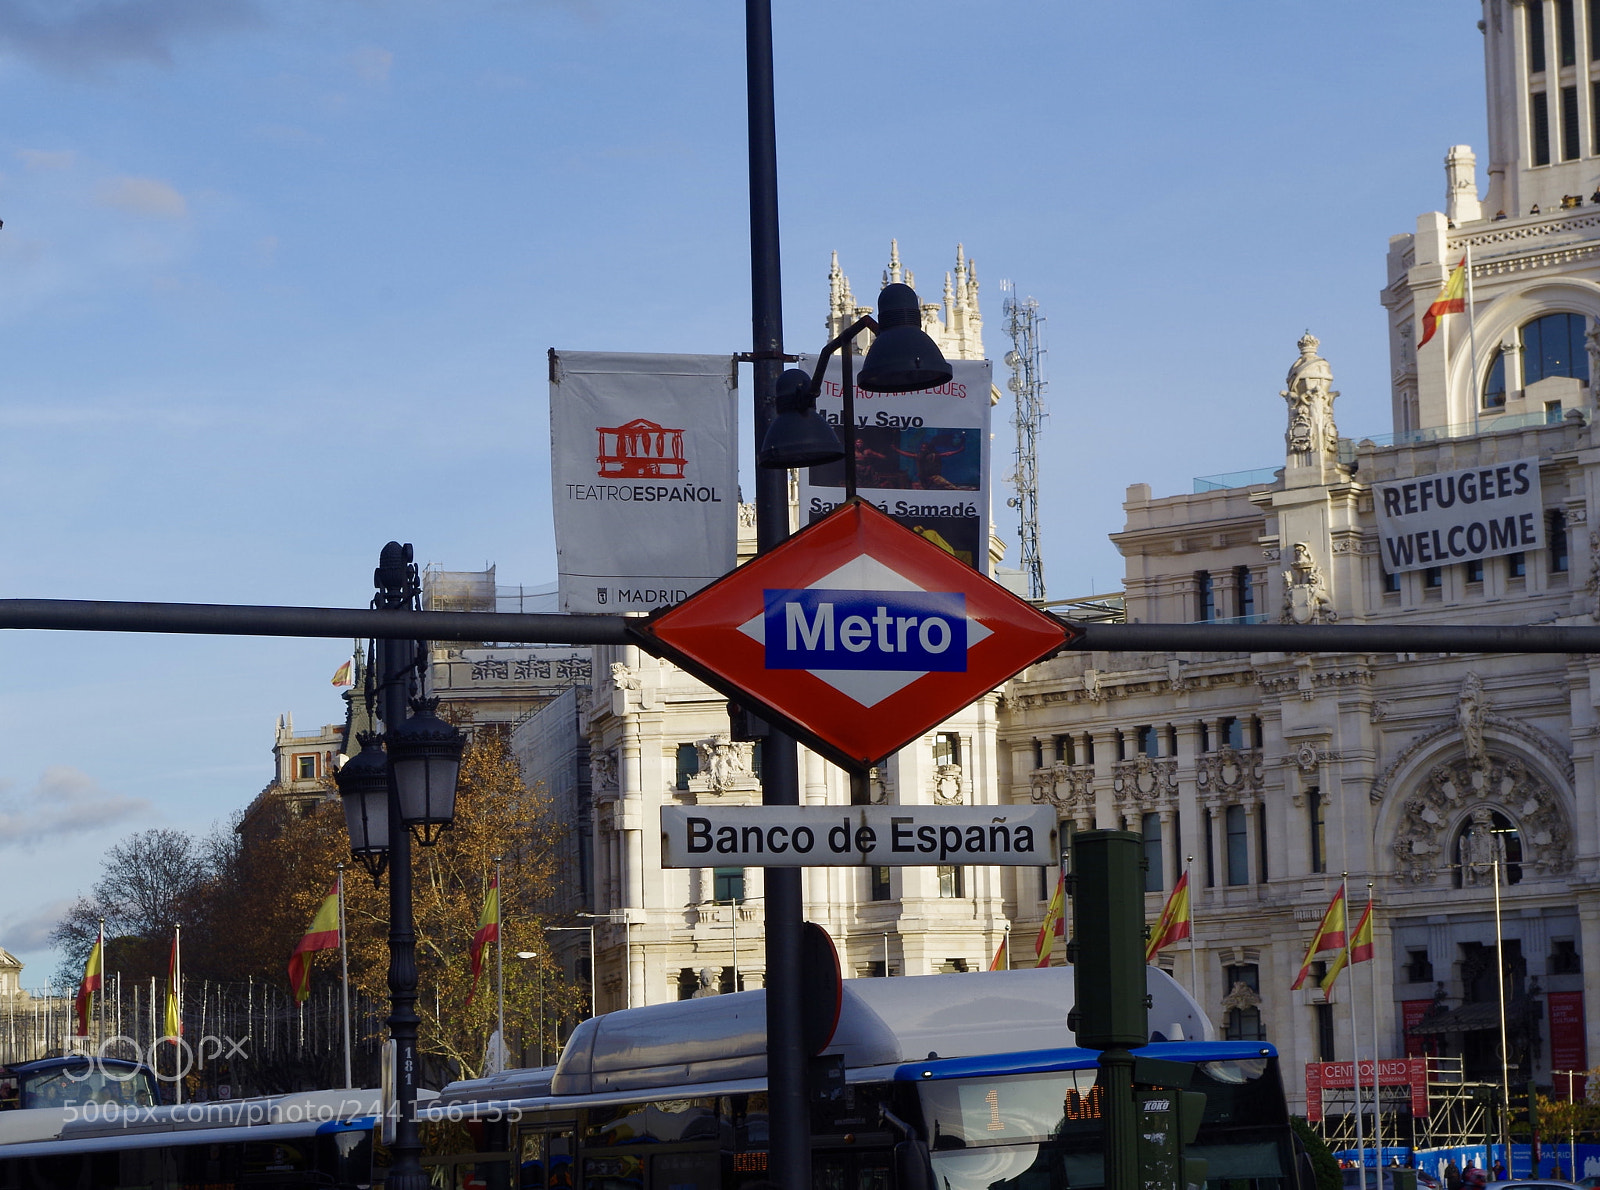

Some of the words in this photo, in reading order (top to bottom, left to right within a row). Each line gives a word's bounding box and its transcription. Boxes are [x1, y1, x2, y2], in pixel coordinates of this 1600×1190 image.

[858, 415, 868, 429] y
[875, 411, 924, 431] Sayo
[895, 500, 976, 517] Samadé
[1383, 463, 1530, 517] REFUGEES
[1386, 513, 1536, 567] WELCOME
[618, 590, 688, 603] MADRID
[785, 602, 952, 654] Metro
[686, 817, 814, 854] Banco
[828, 817, 877, 854] de
[891, 816, 1035, 861] España
[405, 1046, 413, 1086] 181
[984, 1089, 1005, 1131] 1
